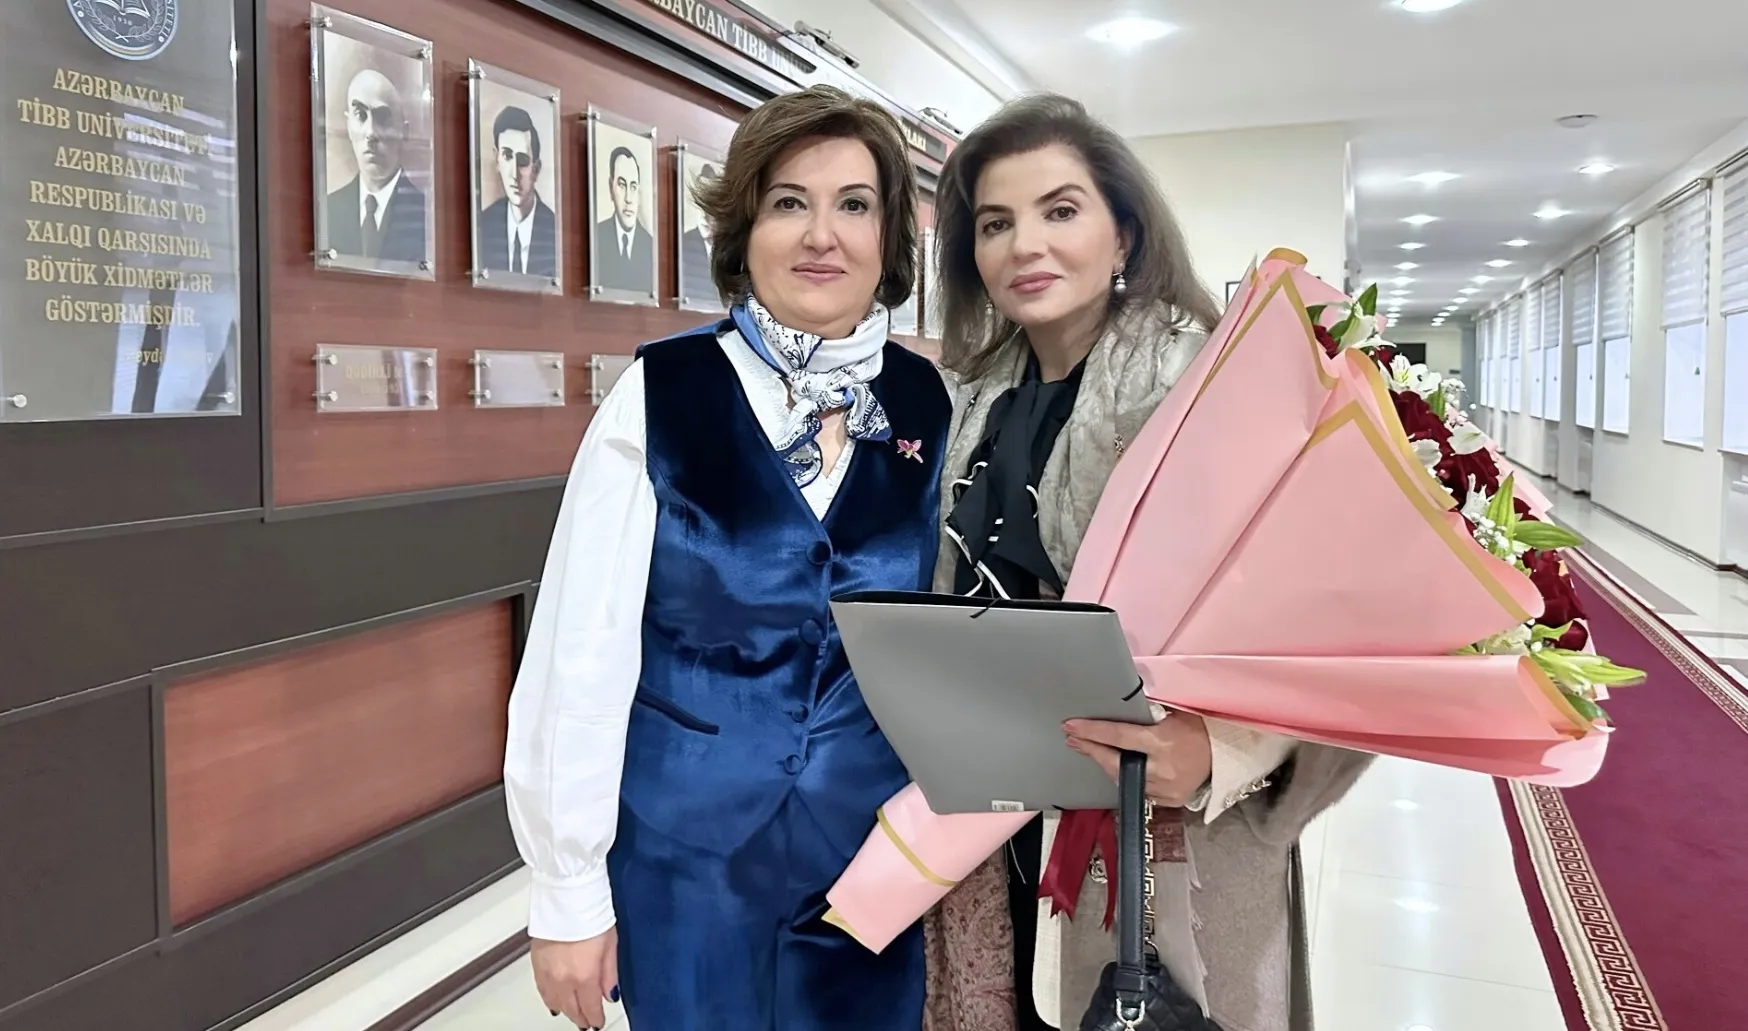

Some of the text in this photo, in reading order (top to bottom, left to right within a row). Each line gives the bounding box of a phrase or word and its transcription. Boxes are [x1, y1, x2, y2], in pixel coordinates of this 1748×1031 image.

[732, 22, 768, 61] TİBB
[53, 68, 184, 116] AZƏRBAYCAN
[17, 97, 71, 130] TİBB
[55, 145, 186, 187] AZƏRBAYCAN
[30, 180, 207, 225] RESPUBLİKASI VƏ
[25, 219, 212, 259] XALQI QARŞISINDA
[25, 255, 214, 293] BÖYÜK XİDMƏTLƏR
[45, 294, 201, 330] GÖSTƏRMİŞDİR.
